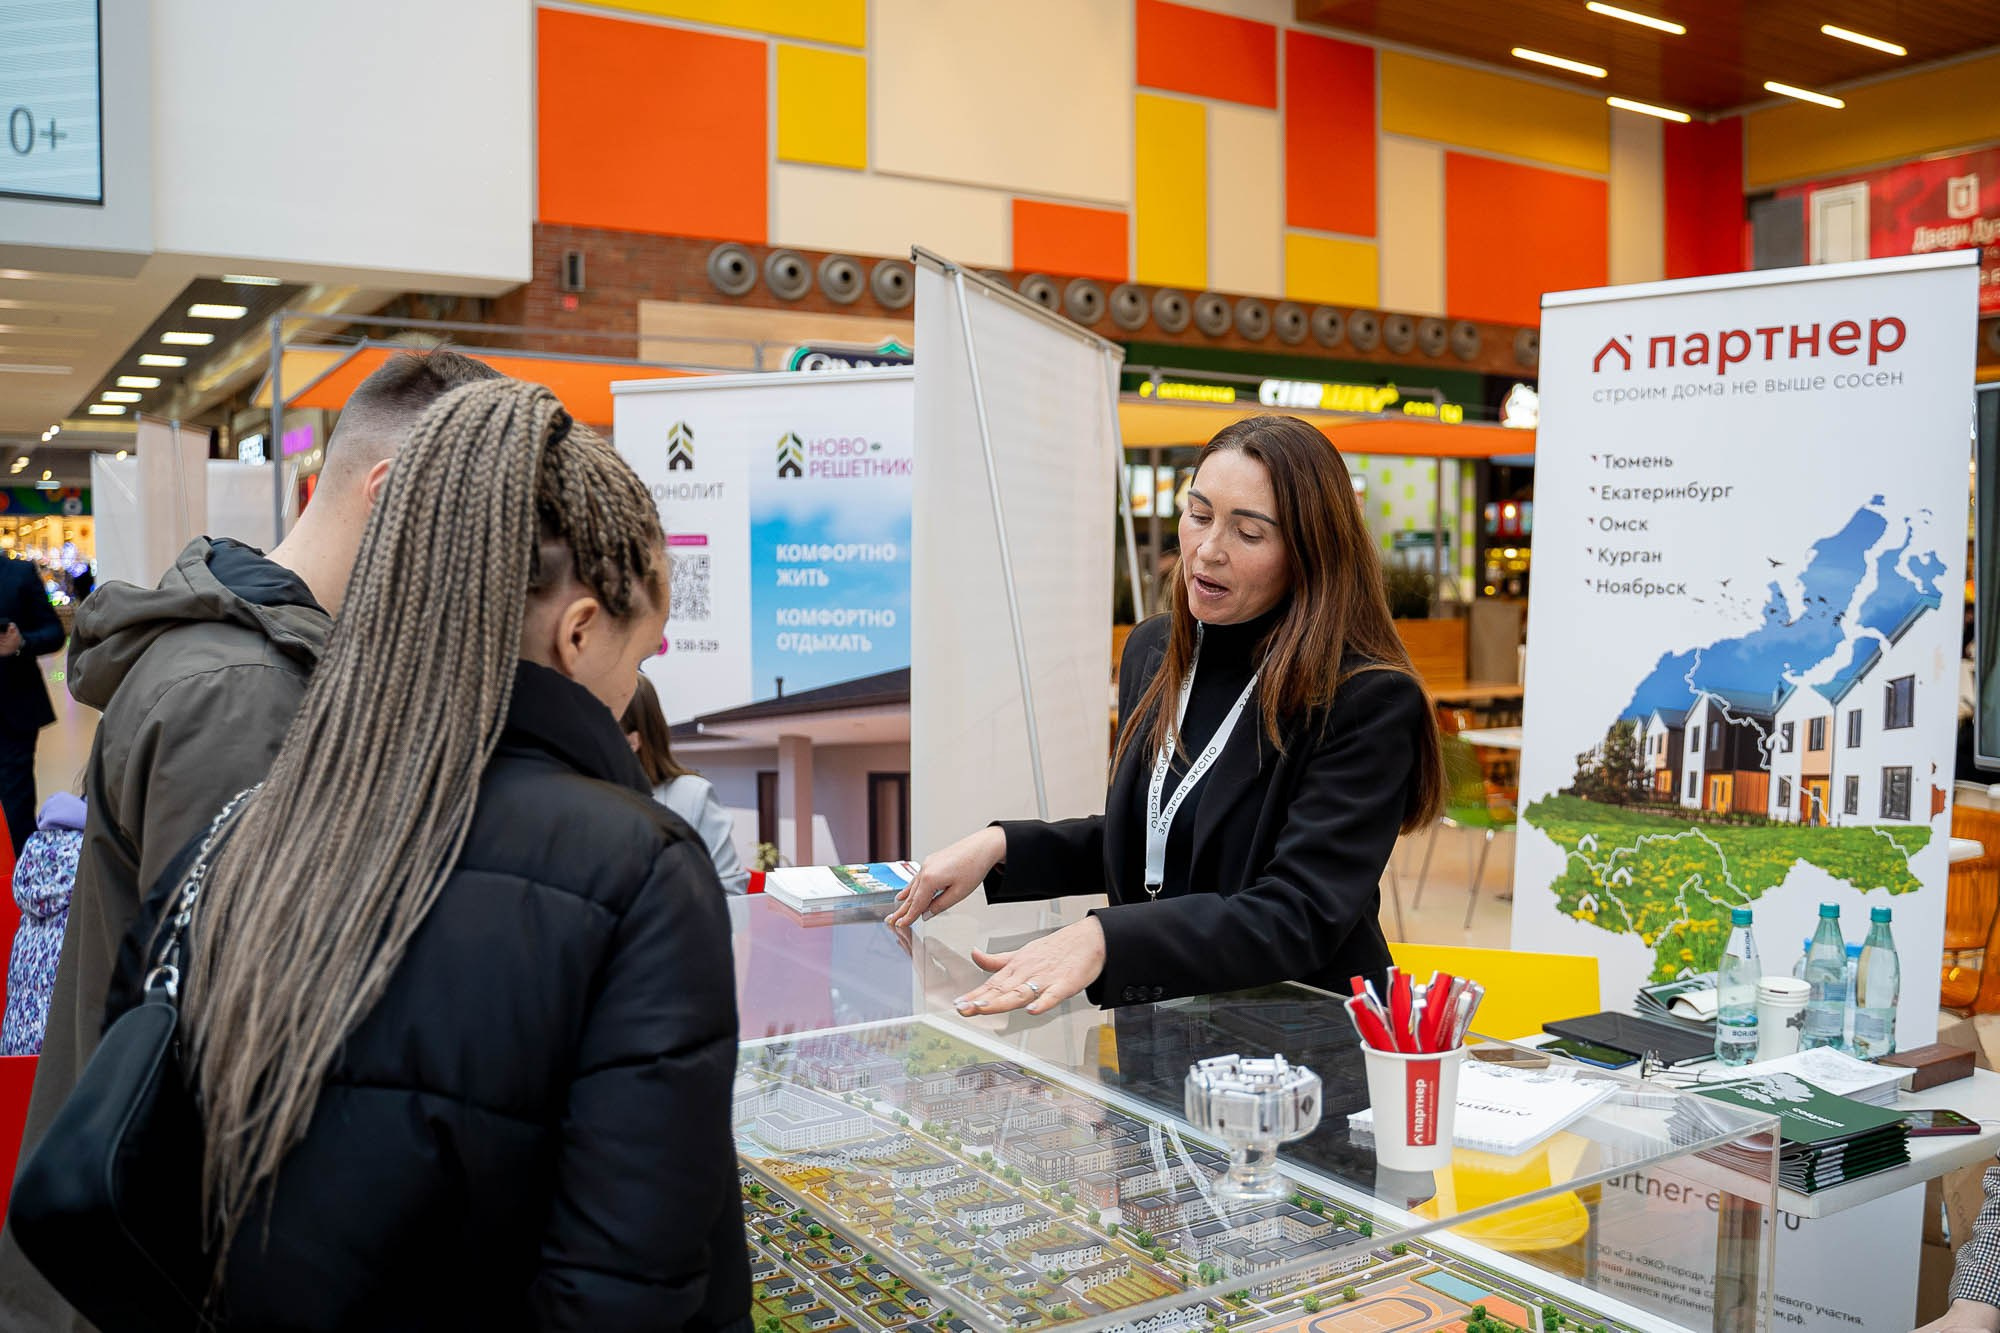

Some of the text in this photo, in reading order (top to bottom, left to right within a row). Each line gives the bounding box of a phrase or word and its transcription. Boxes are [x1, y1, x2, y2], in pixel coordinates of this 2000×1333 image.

[9, 106, 68, 153] 0+
[1649, 316, 1907, 376] партнер
[1592, 370, 1905, 404] строим дома не выше сосен
[1603, 454, 1674, 469] Тюмень
[1600, 481, 1734, 503] Екатеринбург
[1599, 516, 1649, 532] Омск
[775, 543, 897, 563] КОМФОРТНО
[1597, 547, 1662, 566] Курган
[775, 568, 830, 587] ЖИТЬ
[1596, 577, 1687, 598] Ноябрьск
[775, 608, 896, 628] КОМФОРТНО
[775, 633, 873, 653] ОТДЫХАТЬ
[1158, 746, 1217, 836] ЗАГОРОД ЭКСПО
[1151, 786, 1160, 829] ЭКСПО
[1414, 1078, 1427, 1133] партнер
[1815, 1303, 1865, 1327] участия,
